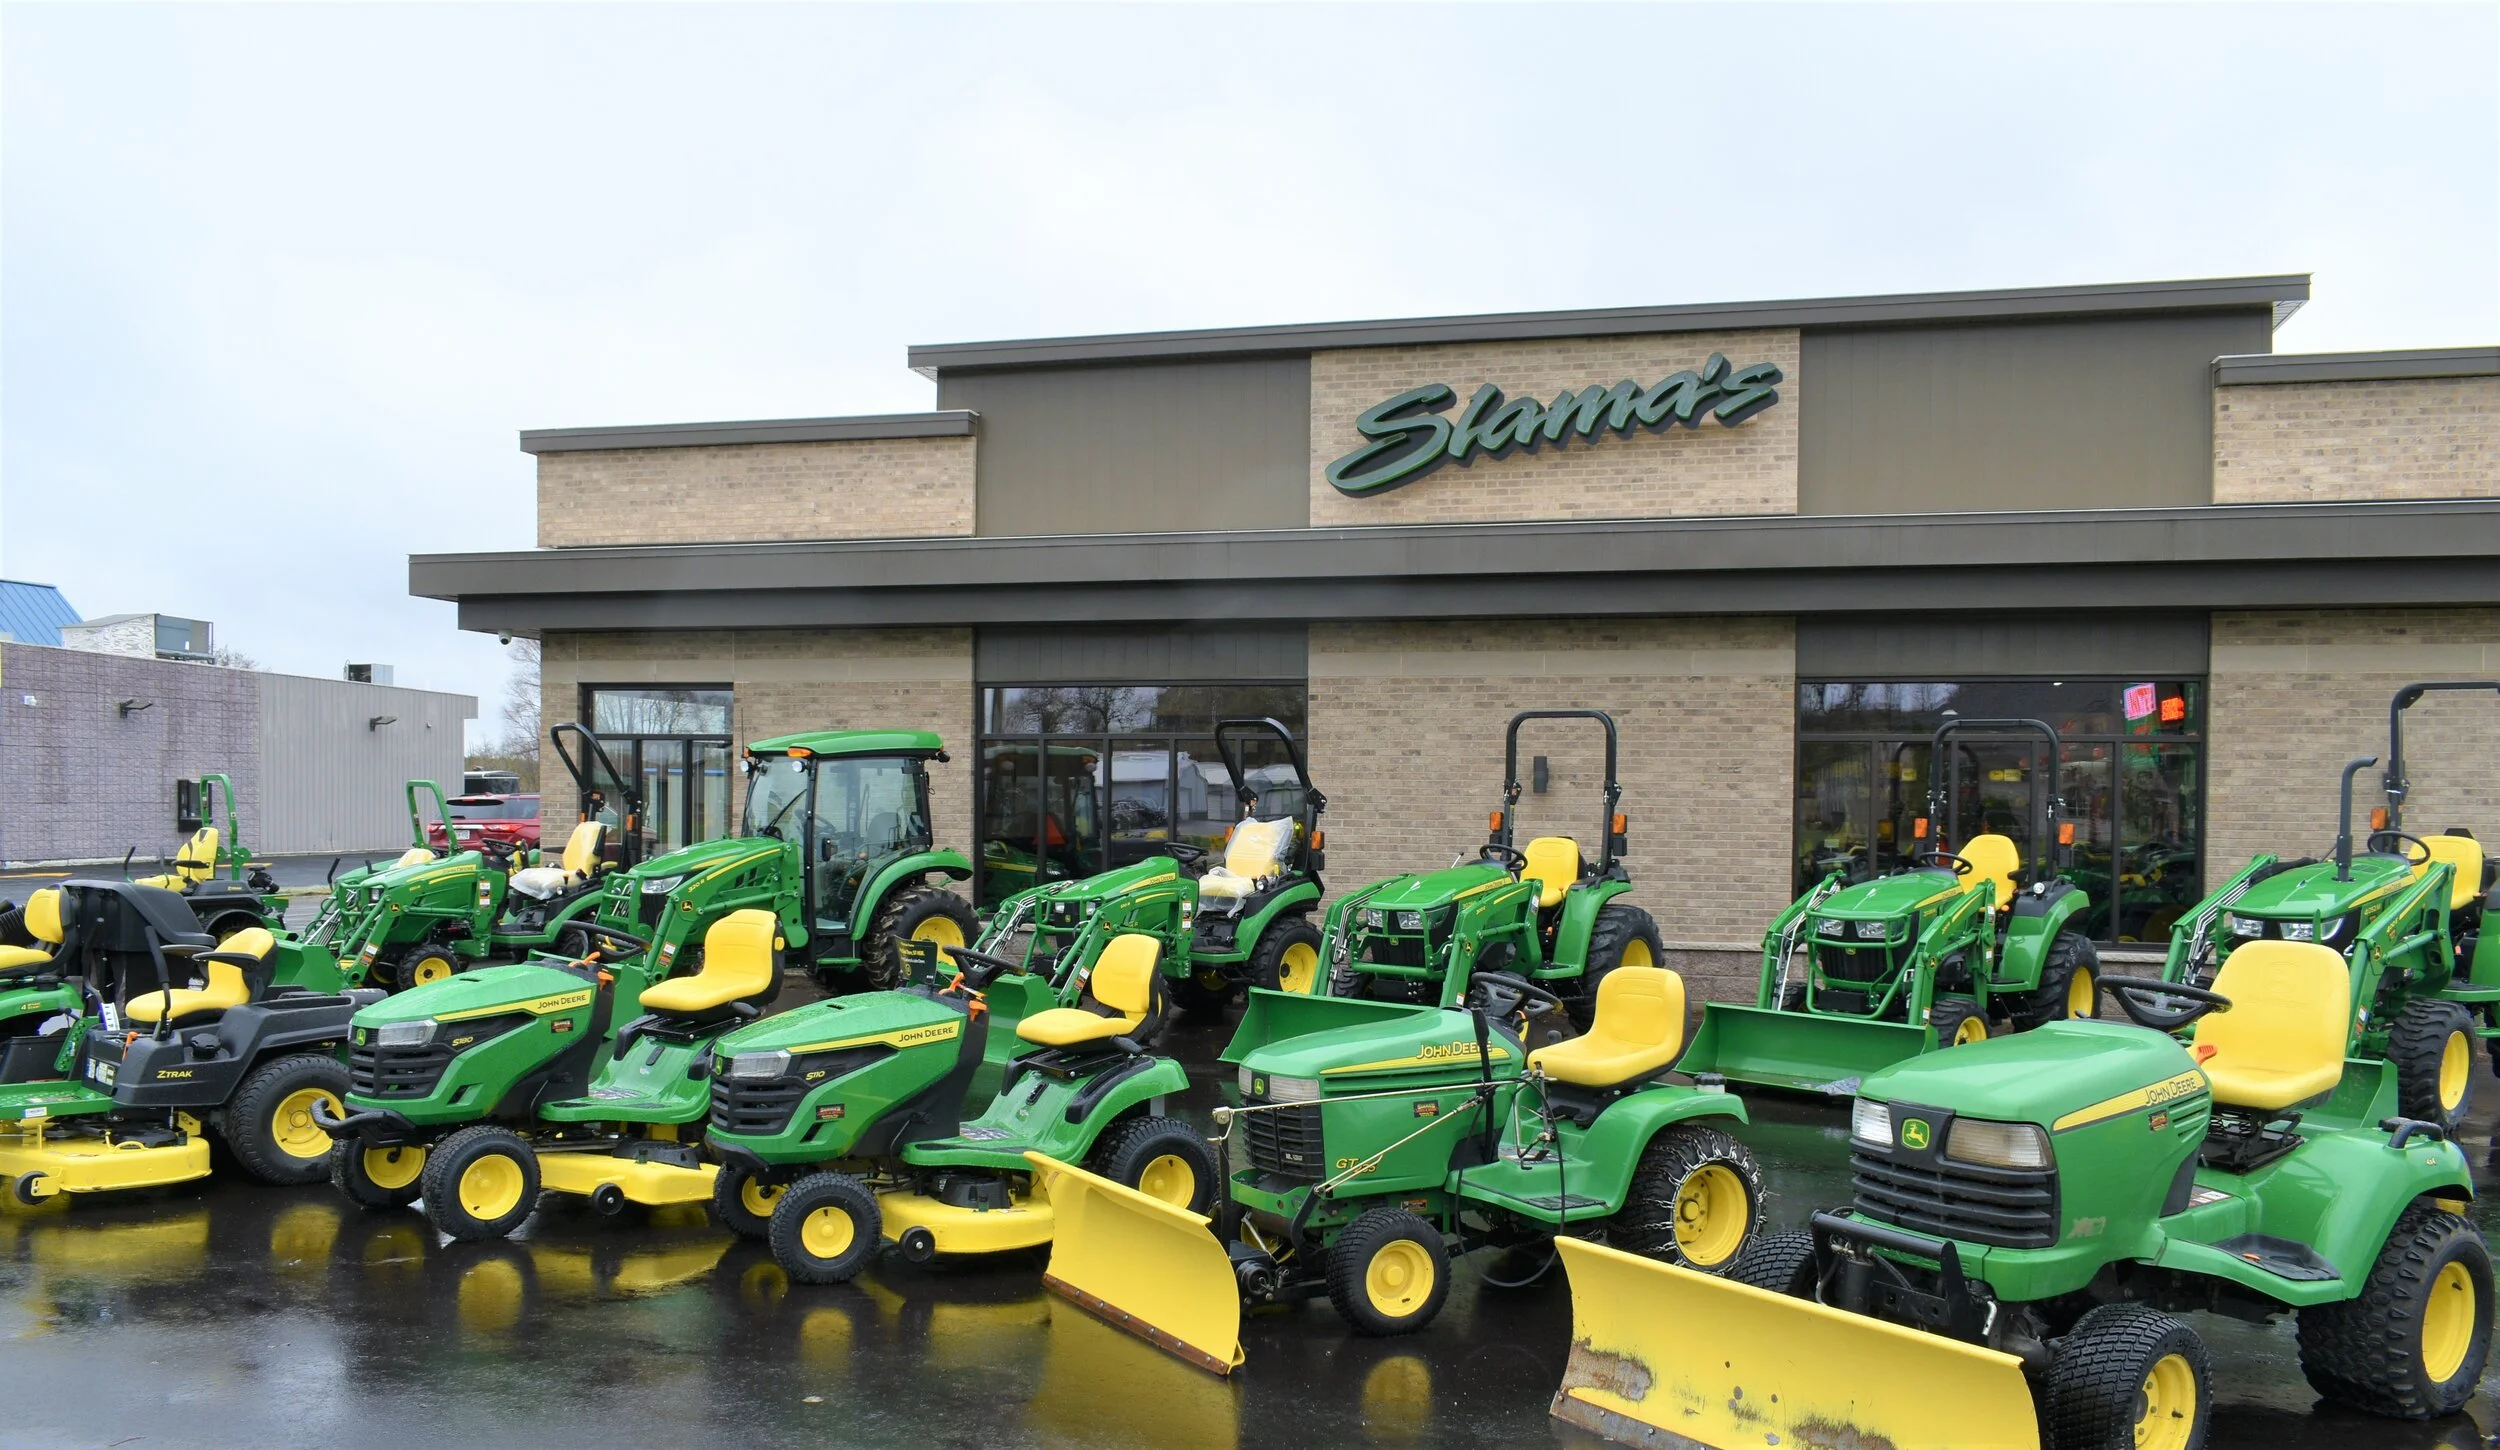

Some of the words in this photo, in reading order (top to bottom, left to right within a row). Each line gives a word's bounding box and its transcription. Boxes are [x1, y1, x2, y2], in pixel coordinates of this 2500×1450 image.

[1324, 351, 1780, 492] Slama's
[537, 999, 560, 1009] JOHN
[561, 994, 587, 1005] DEERE
[452, 1036, 474, 1047] S180
[898, 1032, 923, 1042] JOHN
[925, 1026, 954, 1037] DEERE
[1416, 1043, 1451, 1059] JOHN
[1452, 1041, 1492, 1055] DEEE
[156, 1070, 193, 1078] ZTRAK
[805, 1070, 826, 1081] S110
[2145, 1085, 2171, 1105] JOHN
[2169, 1077, 2197, 1096] DEERE
